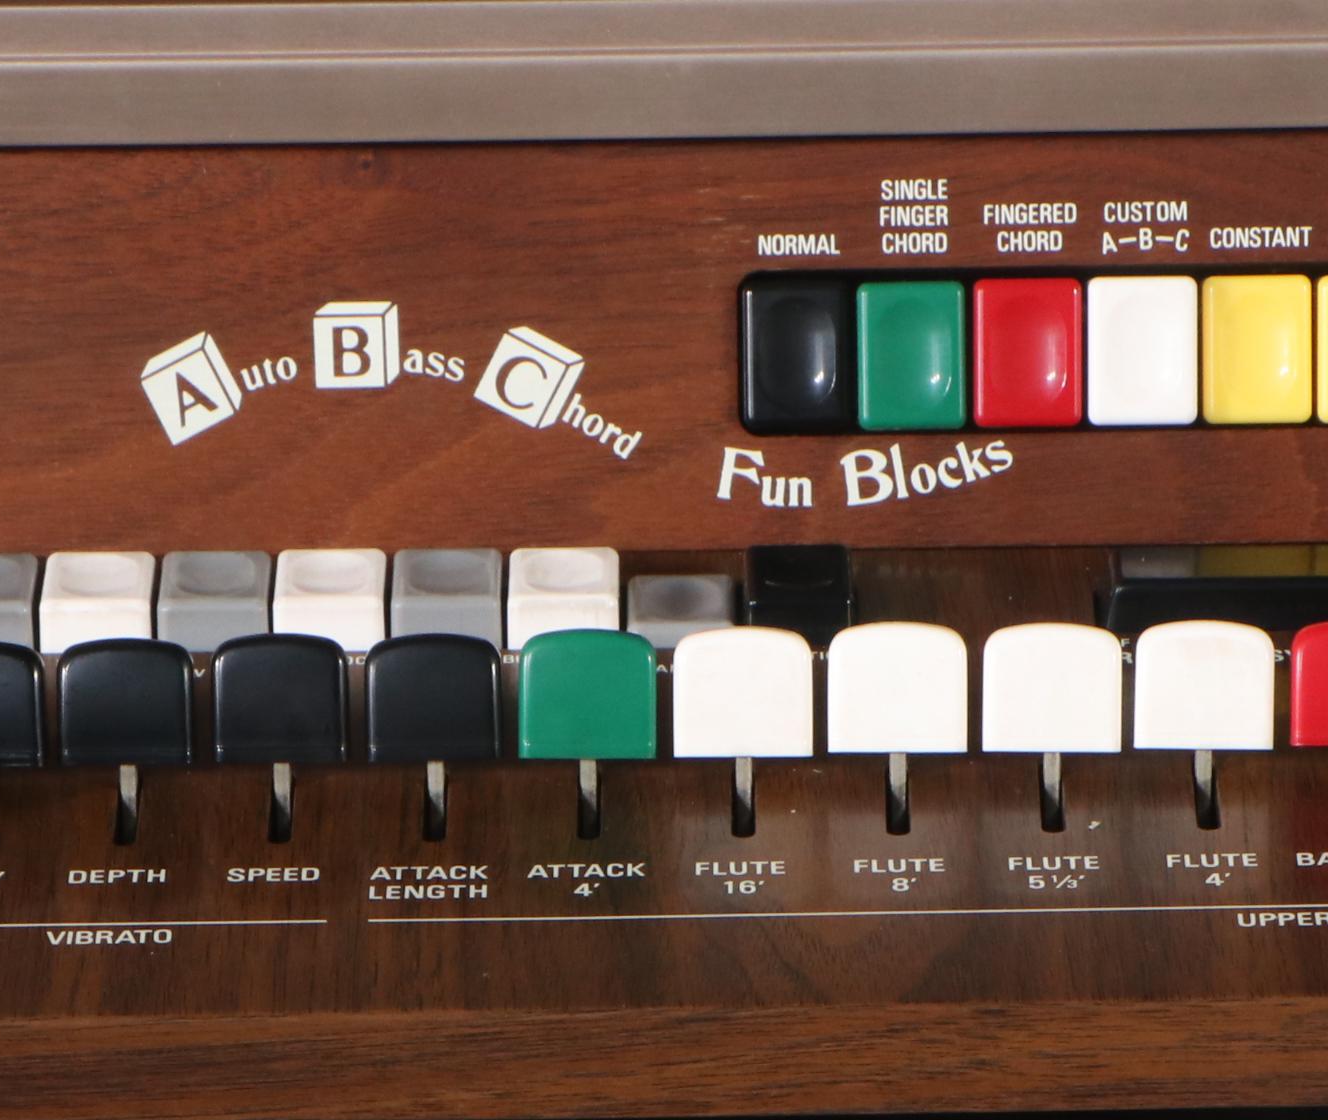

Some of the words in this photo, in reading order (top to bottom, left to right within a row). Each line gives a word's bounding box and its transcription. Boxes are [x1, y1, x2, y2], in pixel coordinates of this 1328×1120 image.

[881, 179, 948, 201] SINGLE
[879, 205, 949, 227] FINGER
[983, 203, 1077, 226] FINGERED
[1104, 201, 1188, 224] CUSTOM
[758, 234, 840, 256] NORMAL
[882, 233, 948, 255] CHORD
[997, 231, 1063, 253] CHORD
[1210, 226, 1312, 249] CONSTANT
[717, 447, 812, 507] Fun
[840, 440, 1013, 506] Blocks
[695, 861, 786, 876] FLUTE
[854, 859, 945, 873] FLUTE
[1008, 856, 1099, 870] FLUTE
[1166, 853, 1258, 868] FLUTE
[68, 869, 166, 884] DEPTH
[227, 867, 320, 883] SPEED
[370, 865, 488, 881] ATTACK
[527, 862, 645, 878] ATTACK
[369, 884, 488, 900] LENGTH
[46, 929, 172, 945] VIBRATO
